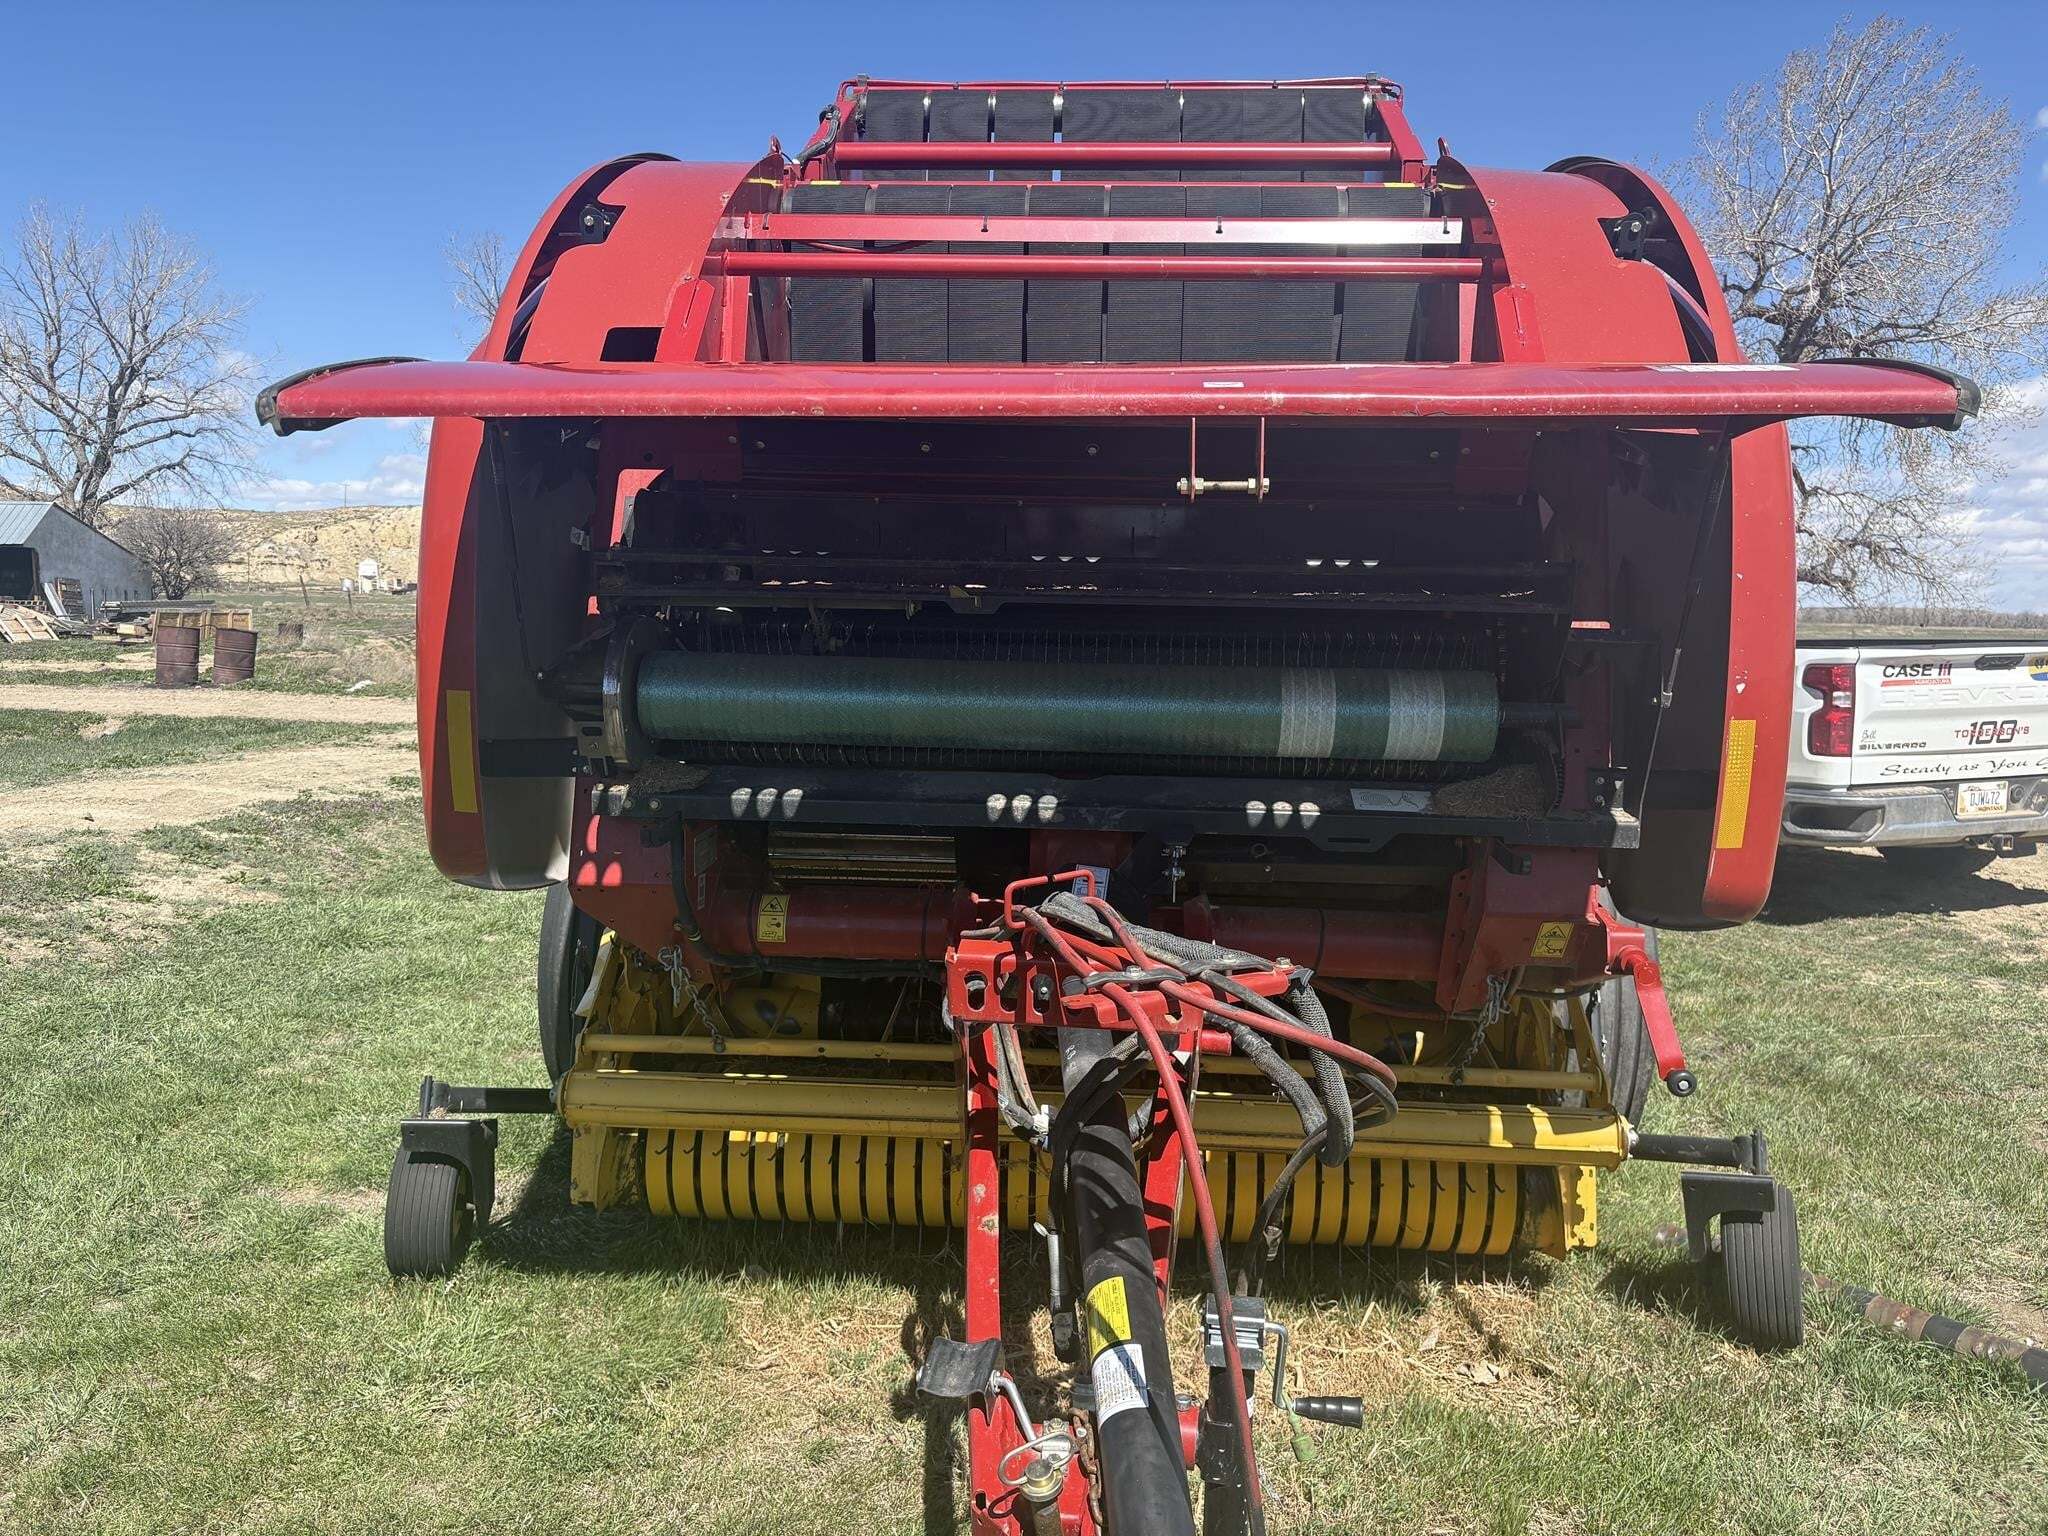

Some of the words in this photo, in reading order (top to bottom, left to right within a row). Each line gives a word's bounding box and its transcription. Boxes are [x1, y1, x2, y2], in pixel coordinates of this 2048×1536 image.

[1882, 663, 1934, 678] CASE
[1968, 719, 2018, 745] 100
[1858, 741, 1927, 750] SILVERADO
[1880, 762, 1950, 776] Steady
[1958, 763, 1980, 771] as
[1986, 758, 2027, 773] You
